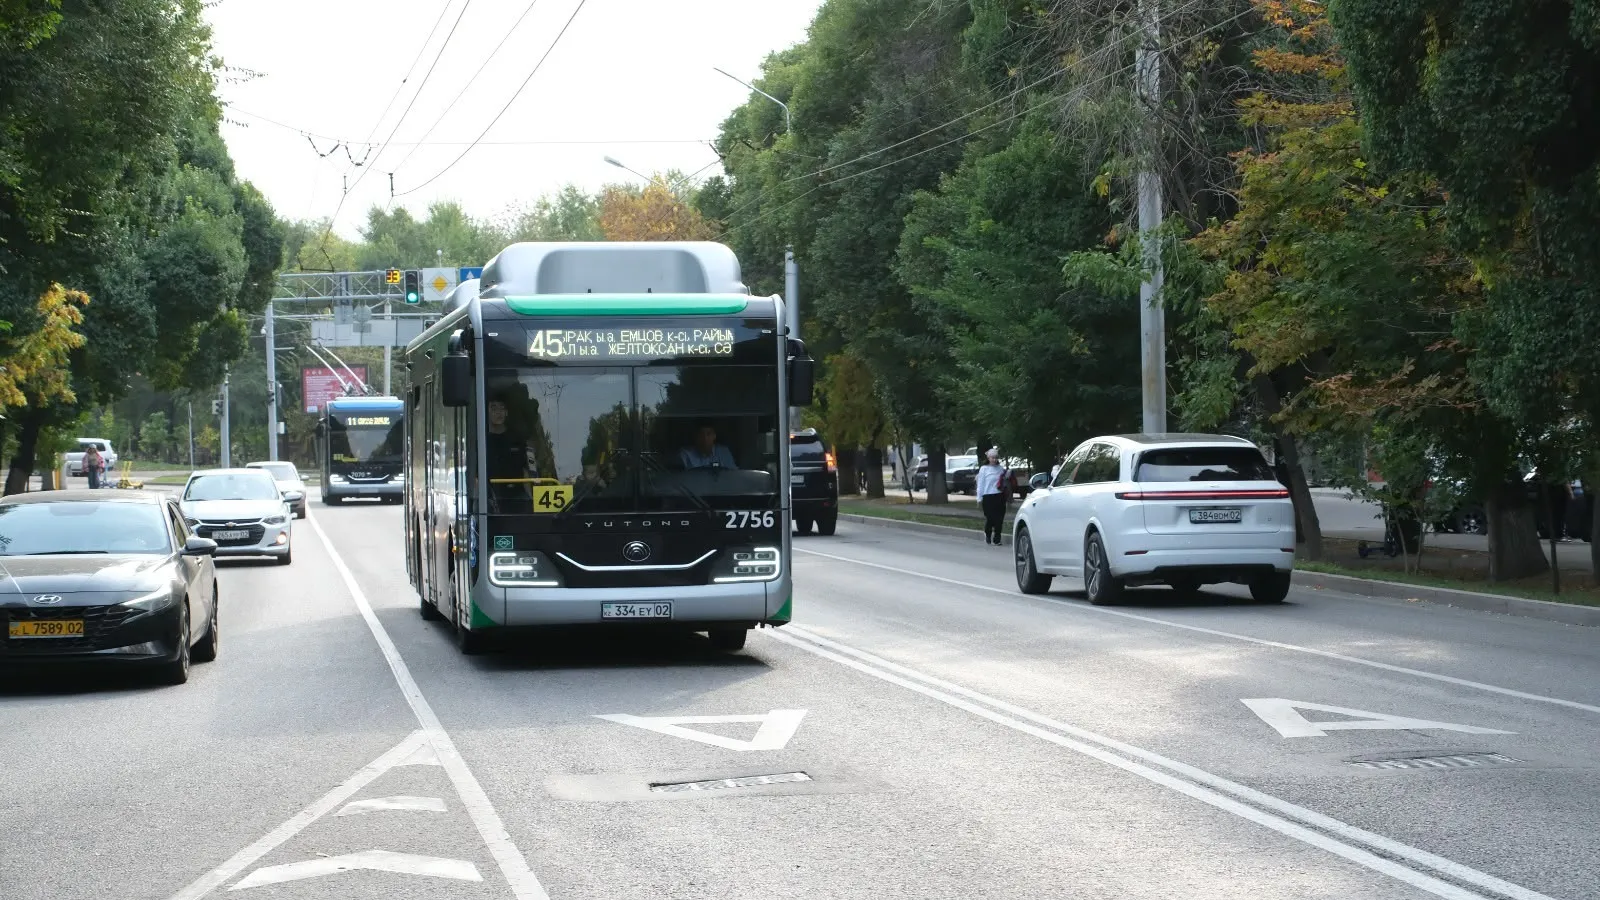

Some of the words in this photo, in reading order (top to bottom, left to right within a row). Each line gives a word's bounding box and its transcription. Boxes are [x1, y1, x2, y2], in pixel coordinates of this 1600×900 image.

[620, 329, 664, 342] ЕМЦОВ
[529, 329, 562, 357] 45
[608, 343, 684, 355] ЖЕЛТОҚСАН
[538, 490, 566, 509] 45
[725, 510, 776, 529] 2756
[1230, 511, 1240, 520] 02
[585, 520, 691, 528] YUTONG
[615, 605, 636, 616] 334
[639, 607, 652, 616] EY
[655, 604, 669, 616] 02
[33, 622, 63, 635] 7589
[68, 622, 82, 634] 02
